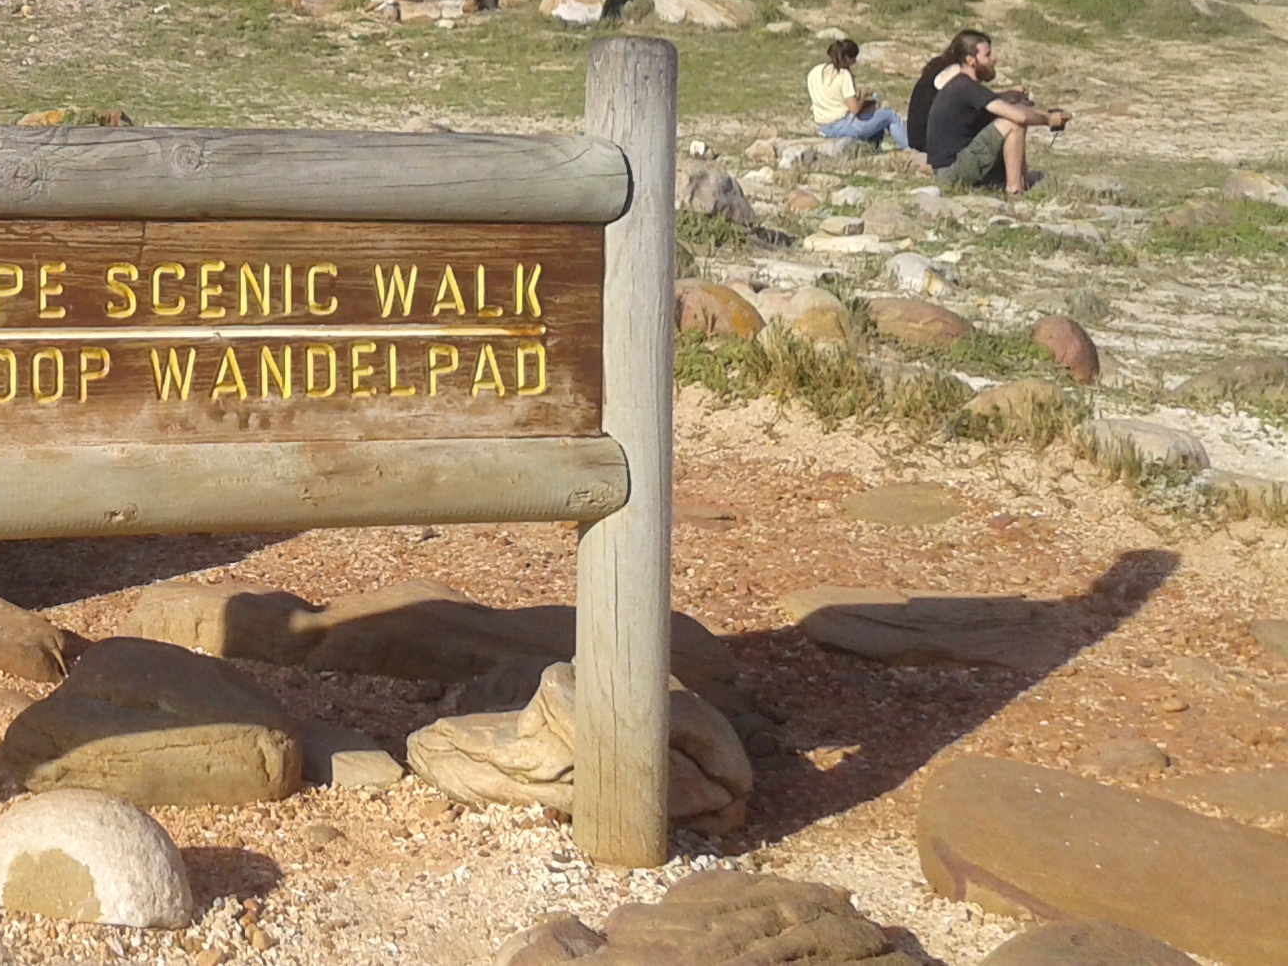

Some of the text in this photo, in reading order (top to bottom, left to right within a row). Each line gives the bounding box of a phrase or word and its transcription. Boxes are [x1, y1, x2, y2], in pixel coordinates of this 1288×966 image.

[105, 260, 339, 321] SCENIC
[373, 262, 543, 319] WALK
[150, 341, 547, 403] WANDELPAD
